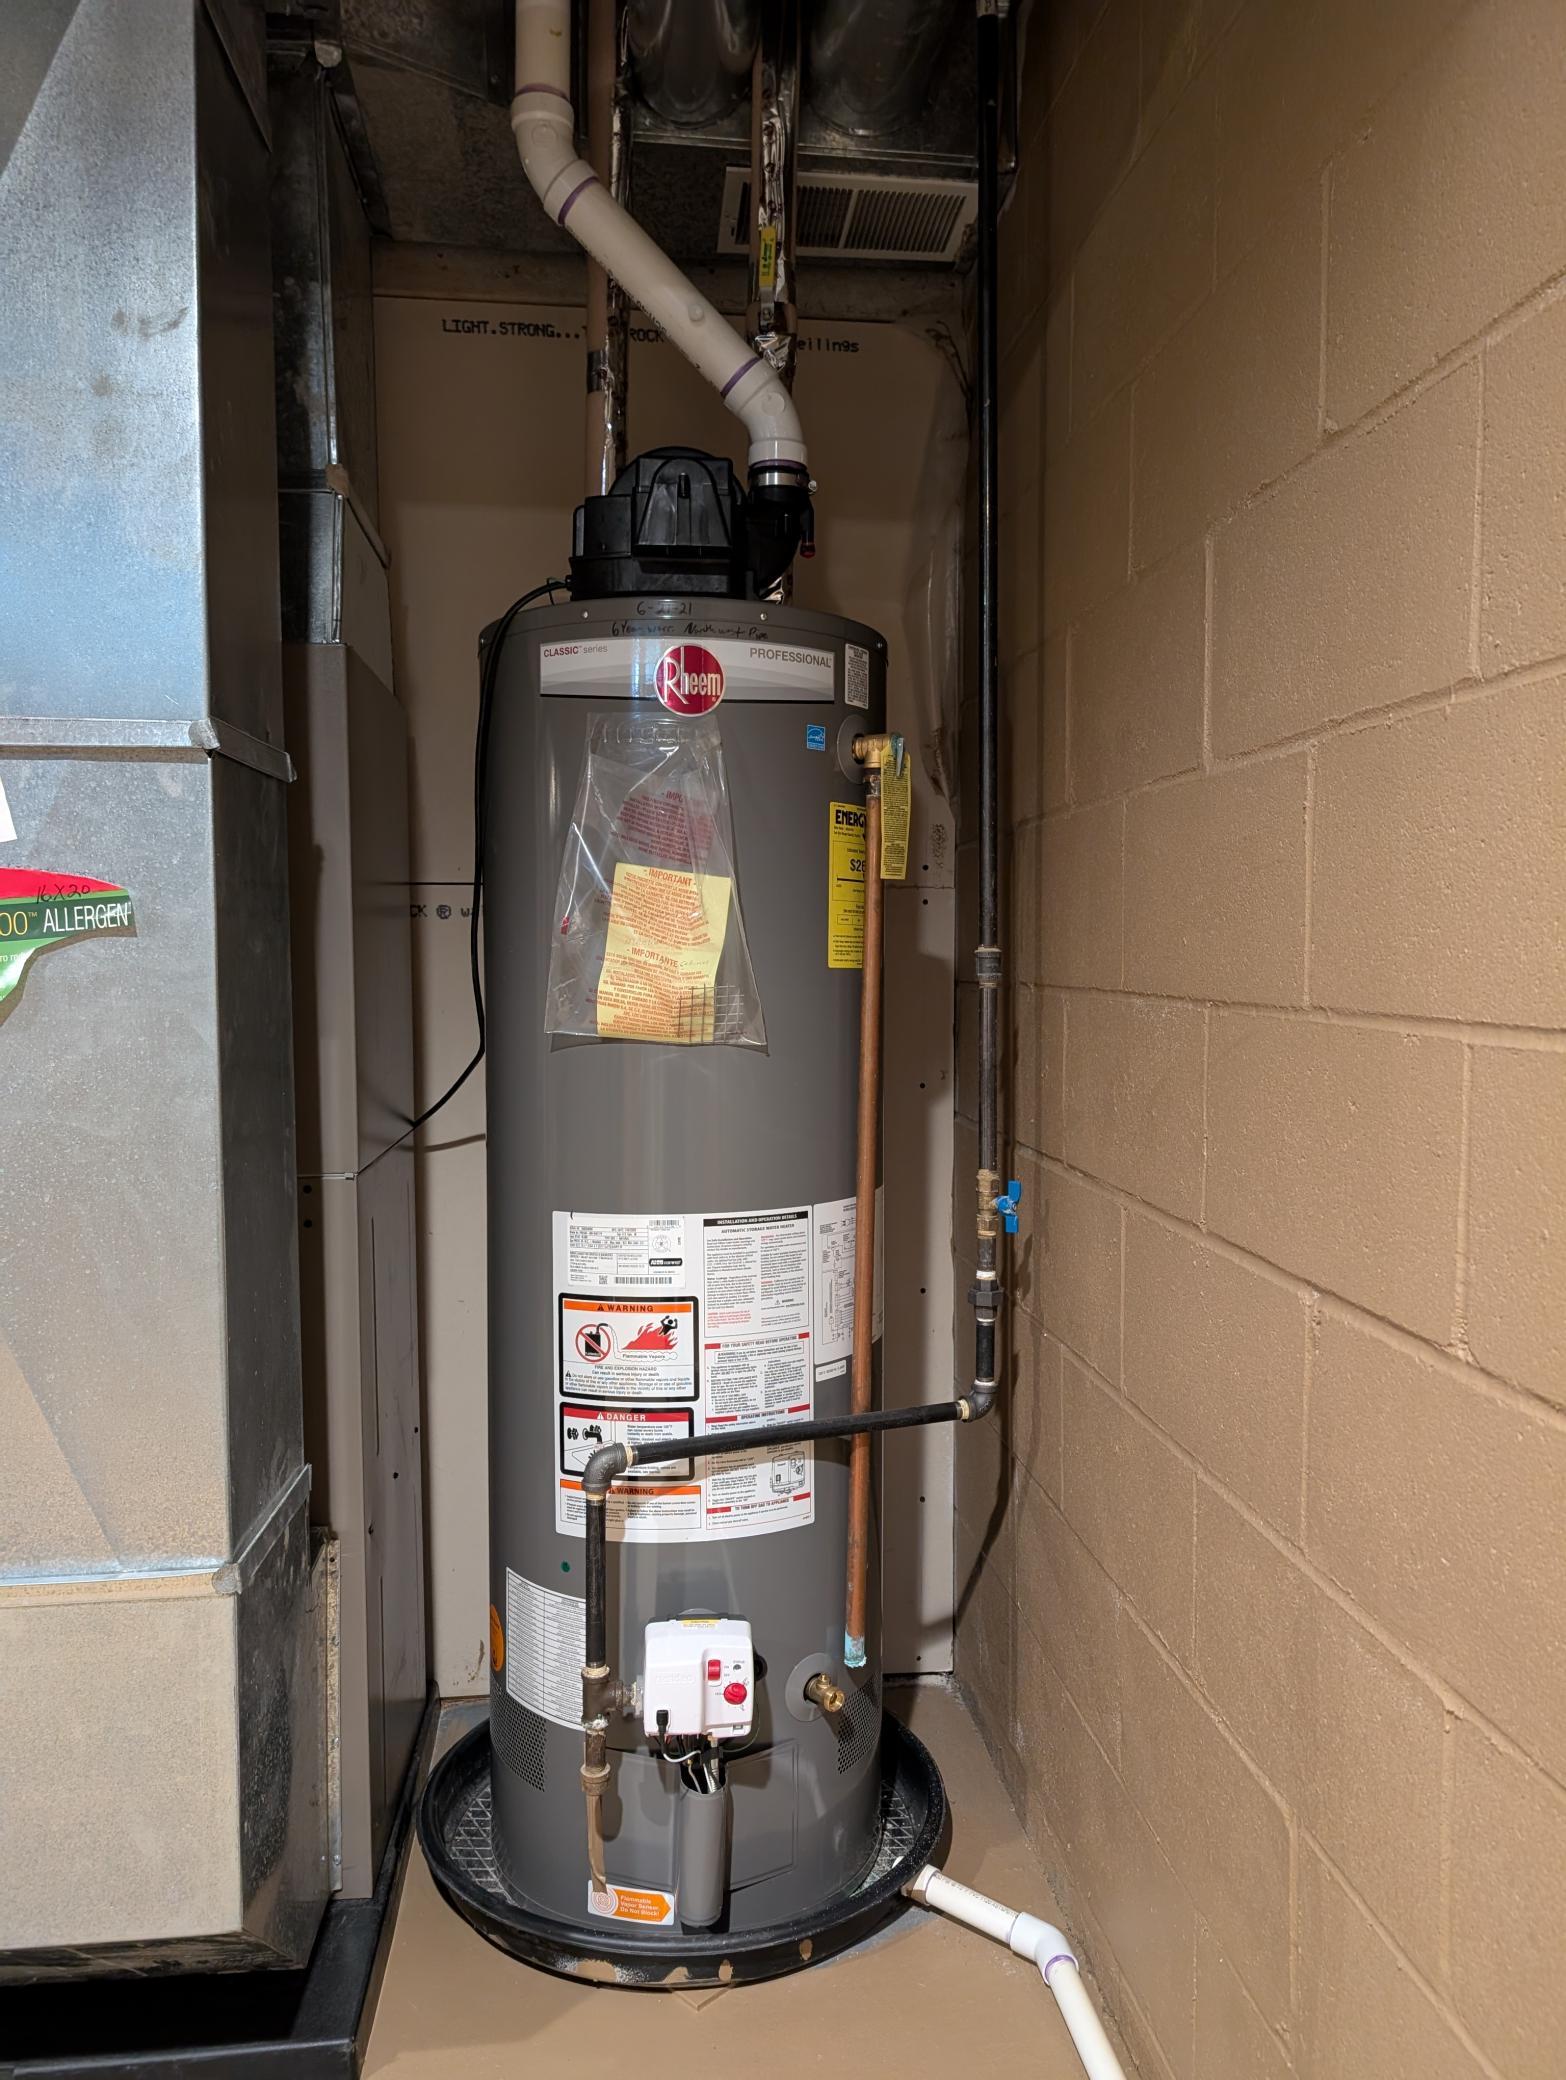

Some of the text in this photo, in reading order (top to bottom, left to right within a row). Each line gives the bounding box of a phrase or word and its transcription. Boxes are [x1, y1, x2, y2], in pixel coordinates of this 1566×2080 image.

[583, 644, 608, 654] series
[664, 646, 721, 705] Rheem
[649, 868, 693, 887] IMPORTANT
[631, 947, 679, 968] IMPORTANTE
[607, 1304, 654, 1312] WARNING
[607, 1413, 646, 1421] DANGER
[616, 1487, 655, 1495] WARNING
[620, 1894, 652, 1904] Flammable
[640, 1909, 660, 1917] Block!
